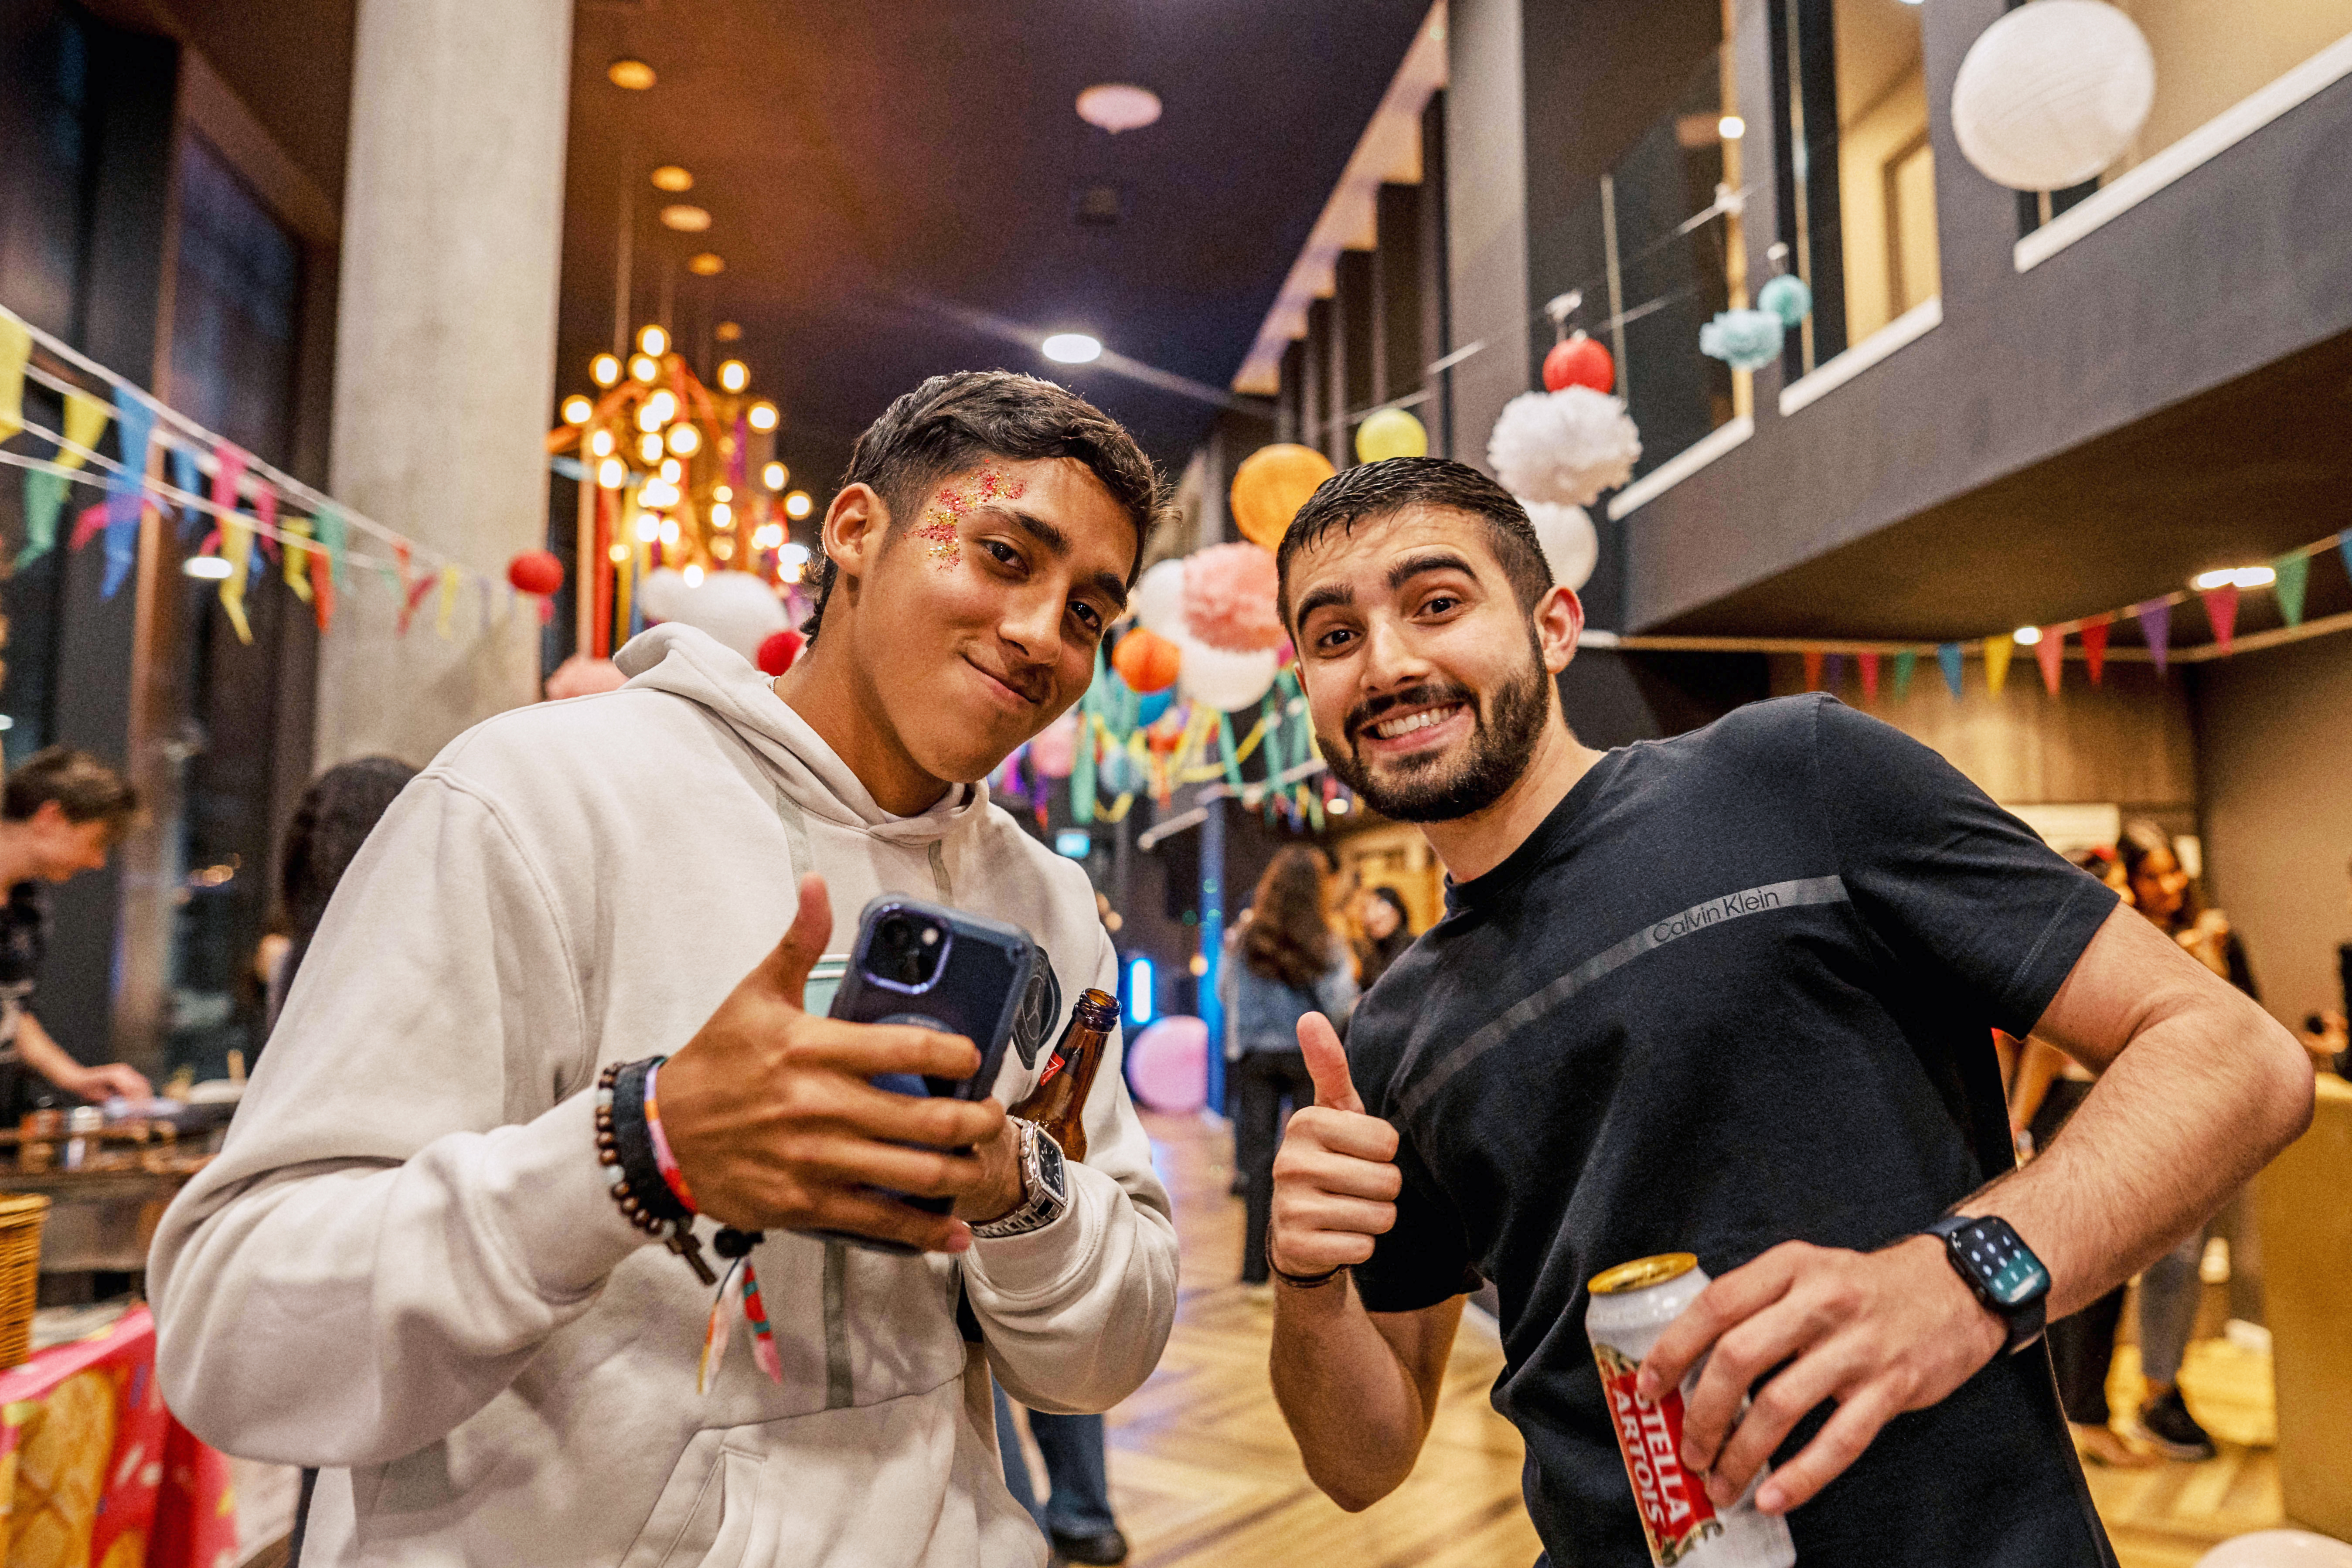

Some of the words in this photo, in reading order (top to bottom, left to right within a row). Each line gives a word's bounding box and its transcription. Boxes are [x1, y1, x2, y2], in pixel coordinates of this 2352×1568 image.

[1653, 907, 1721, 942] Calvin
[1723, 888, 1779, 916] Klein
[1613, 1388, 1666, 1527] ARTOIS
